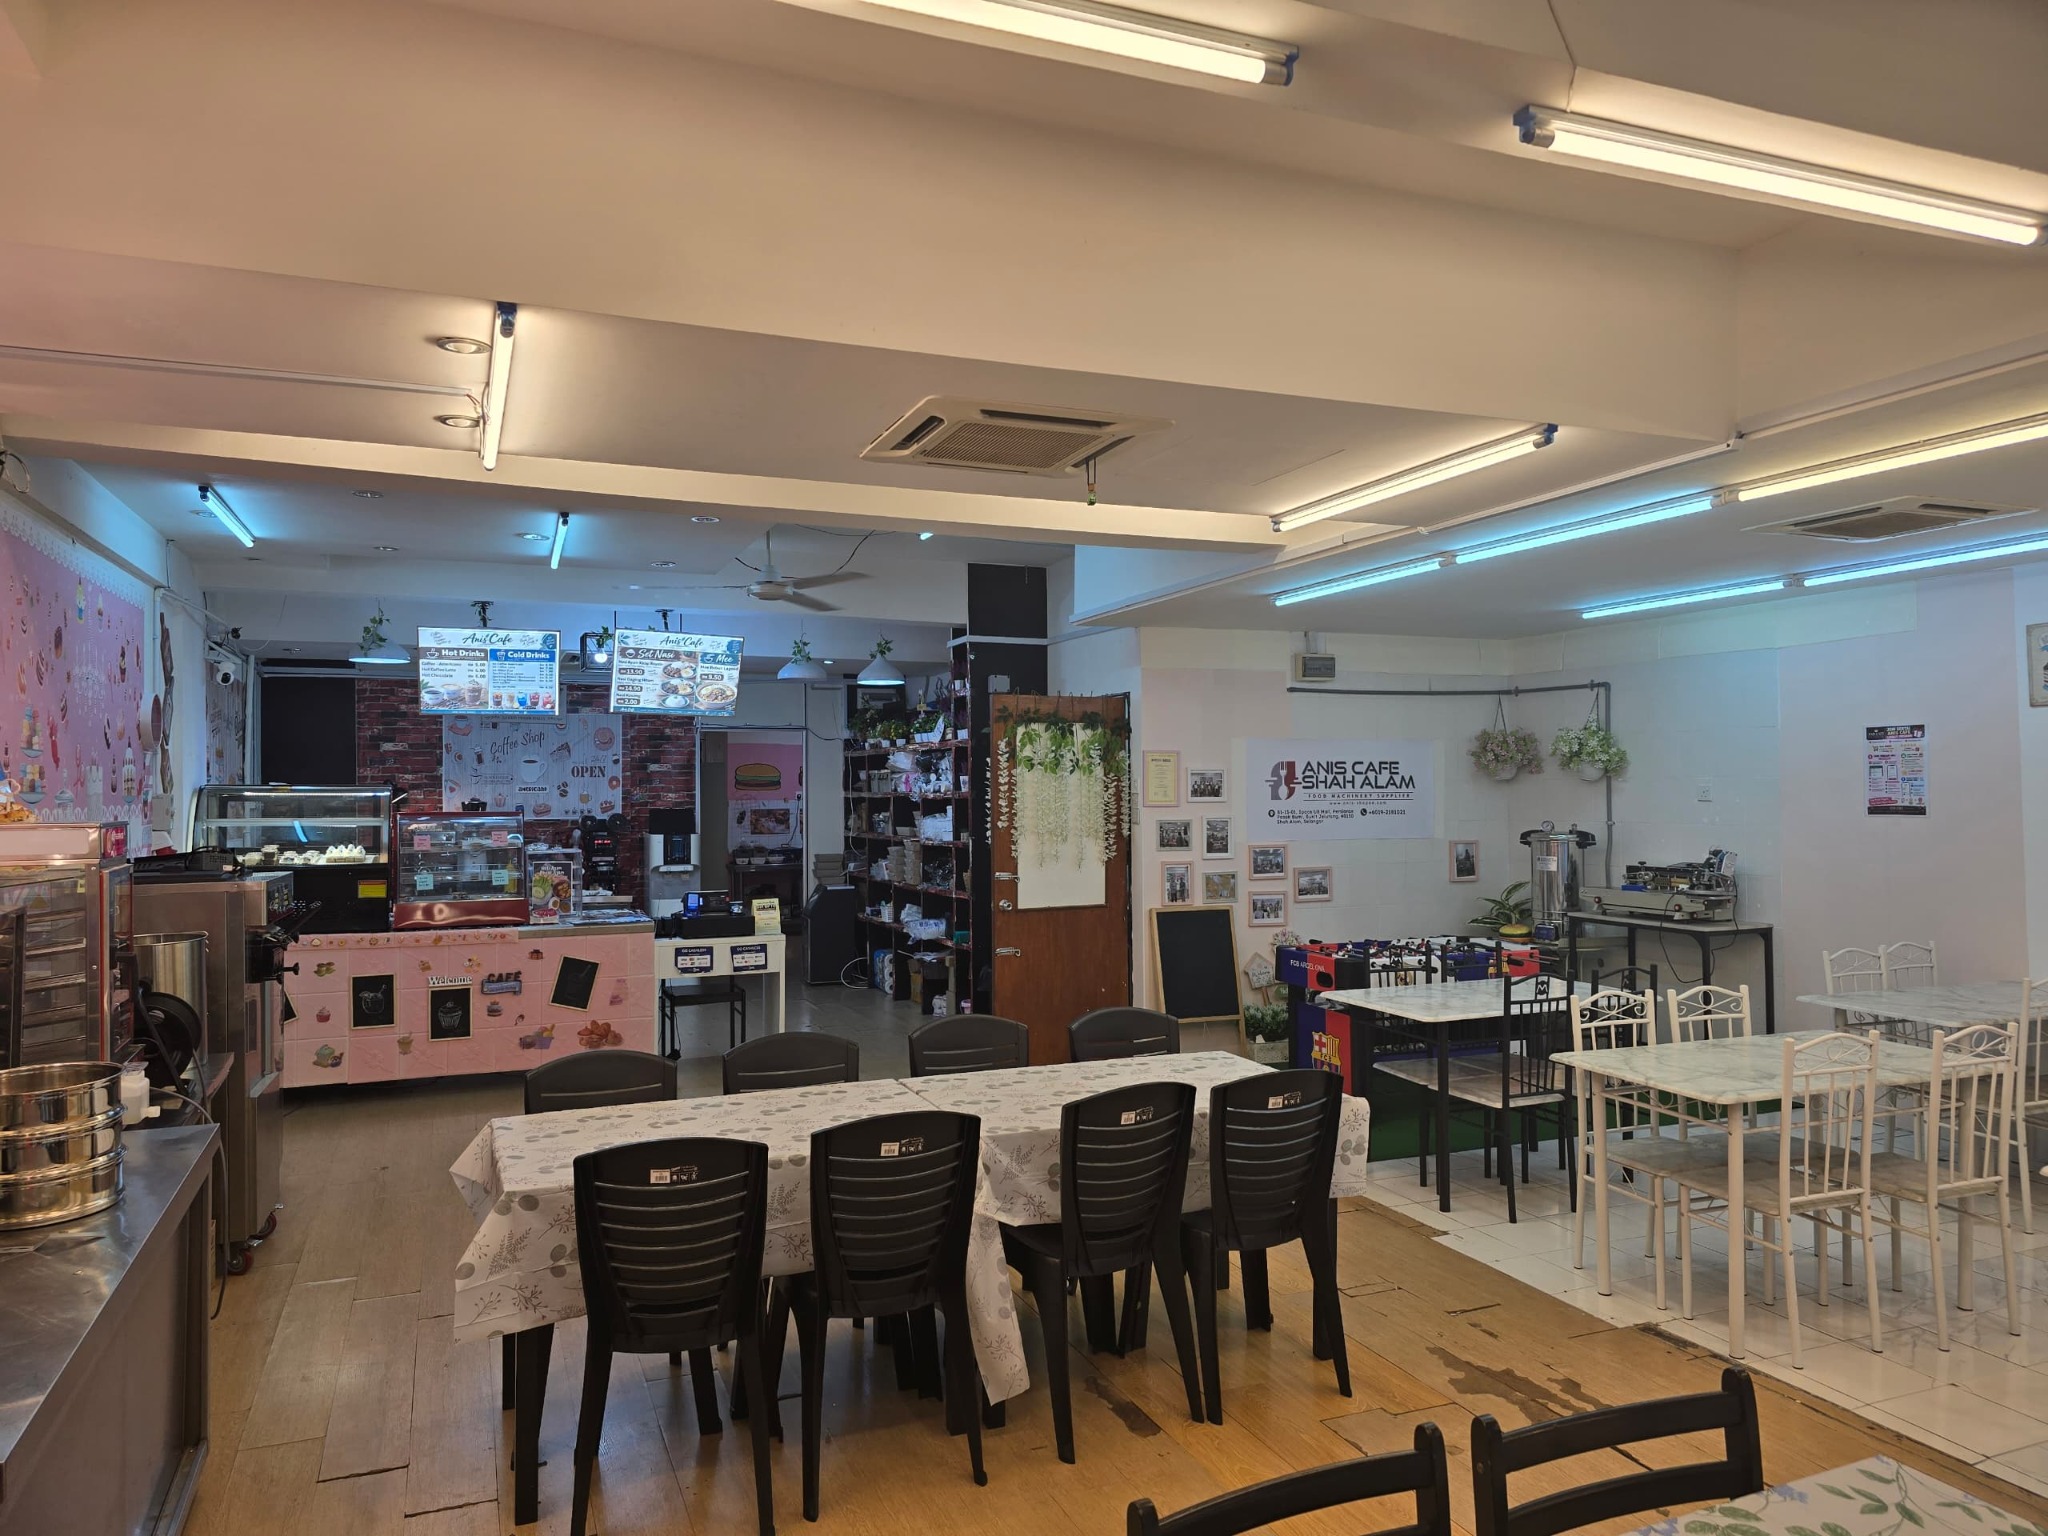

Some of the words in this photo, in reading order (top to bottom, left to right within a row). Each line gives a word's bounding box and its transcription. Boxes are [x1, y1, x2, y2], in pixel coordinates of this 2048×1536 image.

[489, 633, 513, 646] Cafe
[684, 637, 704, 648] Cafe
[526, 651, 550, 659] Drinks
[638, 649, 654, 659] Set
[655, 650, 676, 659] Nasi
[716, 654, 734, 663] Mee
[490, 736, 518, 755] Coffee
[521, 729, 545, 748] Shop
[571, 765, 606, 778] OPEN
[1302, 761, 1347, 775] ANIS
[1351, 761, 1400, 775] CAFE
[1302, 775, 1355, 789] SHAH
[1360, 775, 1415, 789] ALAM
[428, 976, 473, 986] Welcome
[1320, 1053, 1332, 1062] FCB
